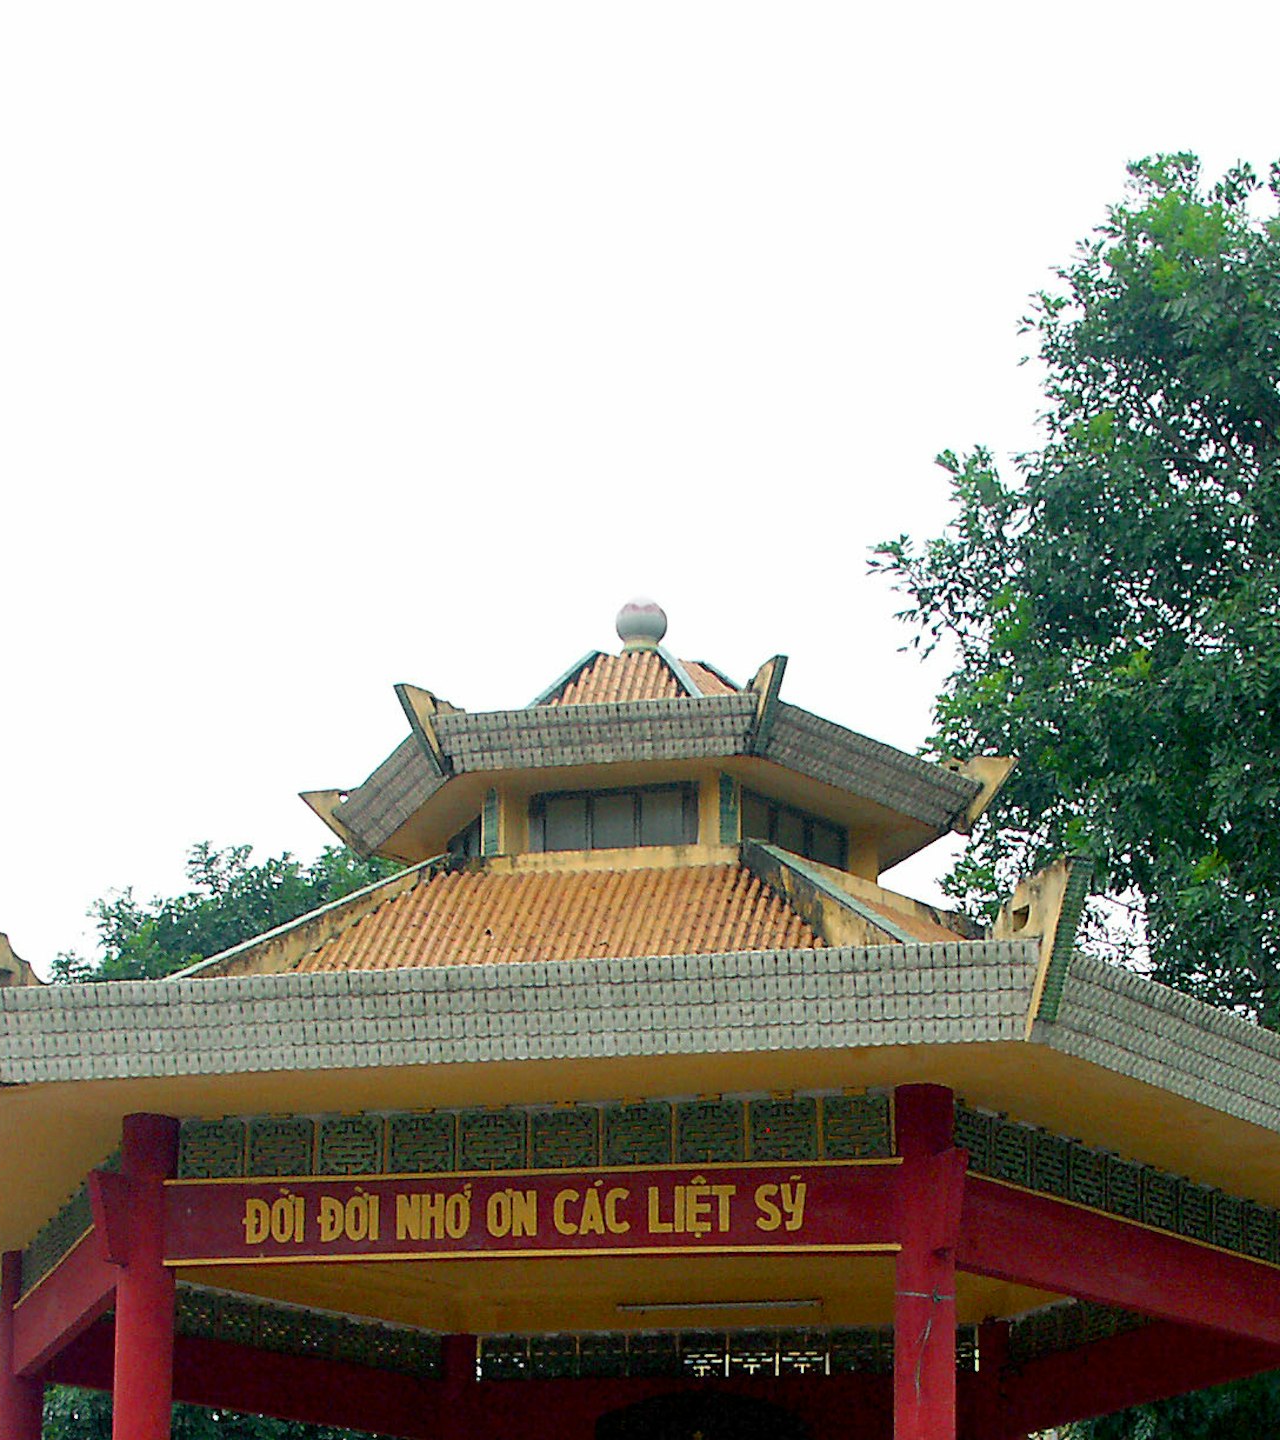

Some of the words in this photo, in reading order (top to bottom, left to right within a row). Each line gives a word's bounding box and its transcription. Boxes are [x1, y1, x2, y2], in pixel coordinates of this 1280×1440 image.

[241, 1187, 305, 1244] ĐỜI
[317, 1186, 379, 1242] ĐỜI
[396, 1183, 472, 1240] NHỚ
[486, 1188, 537, 1238] ƠN
[553, 1179, 631, 1235] CÁC
[648, 1175, 736, 1238] LIỆT
[754, 1174, 807, 1232] SỸ
